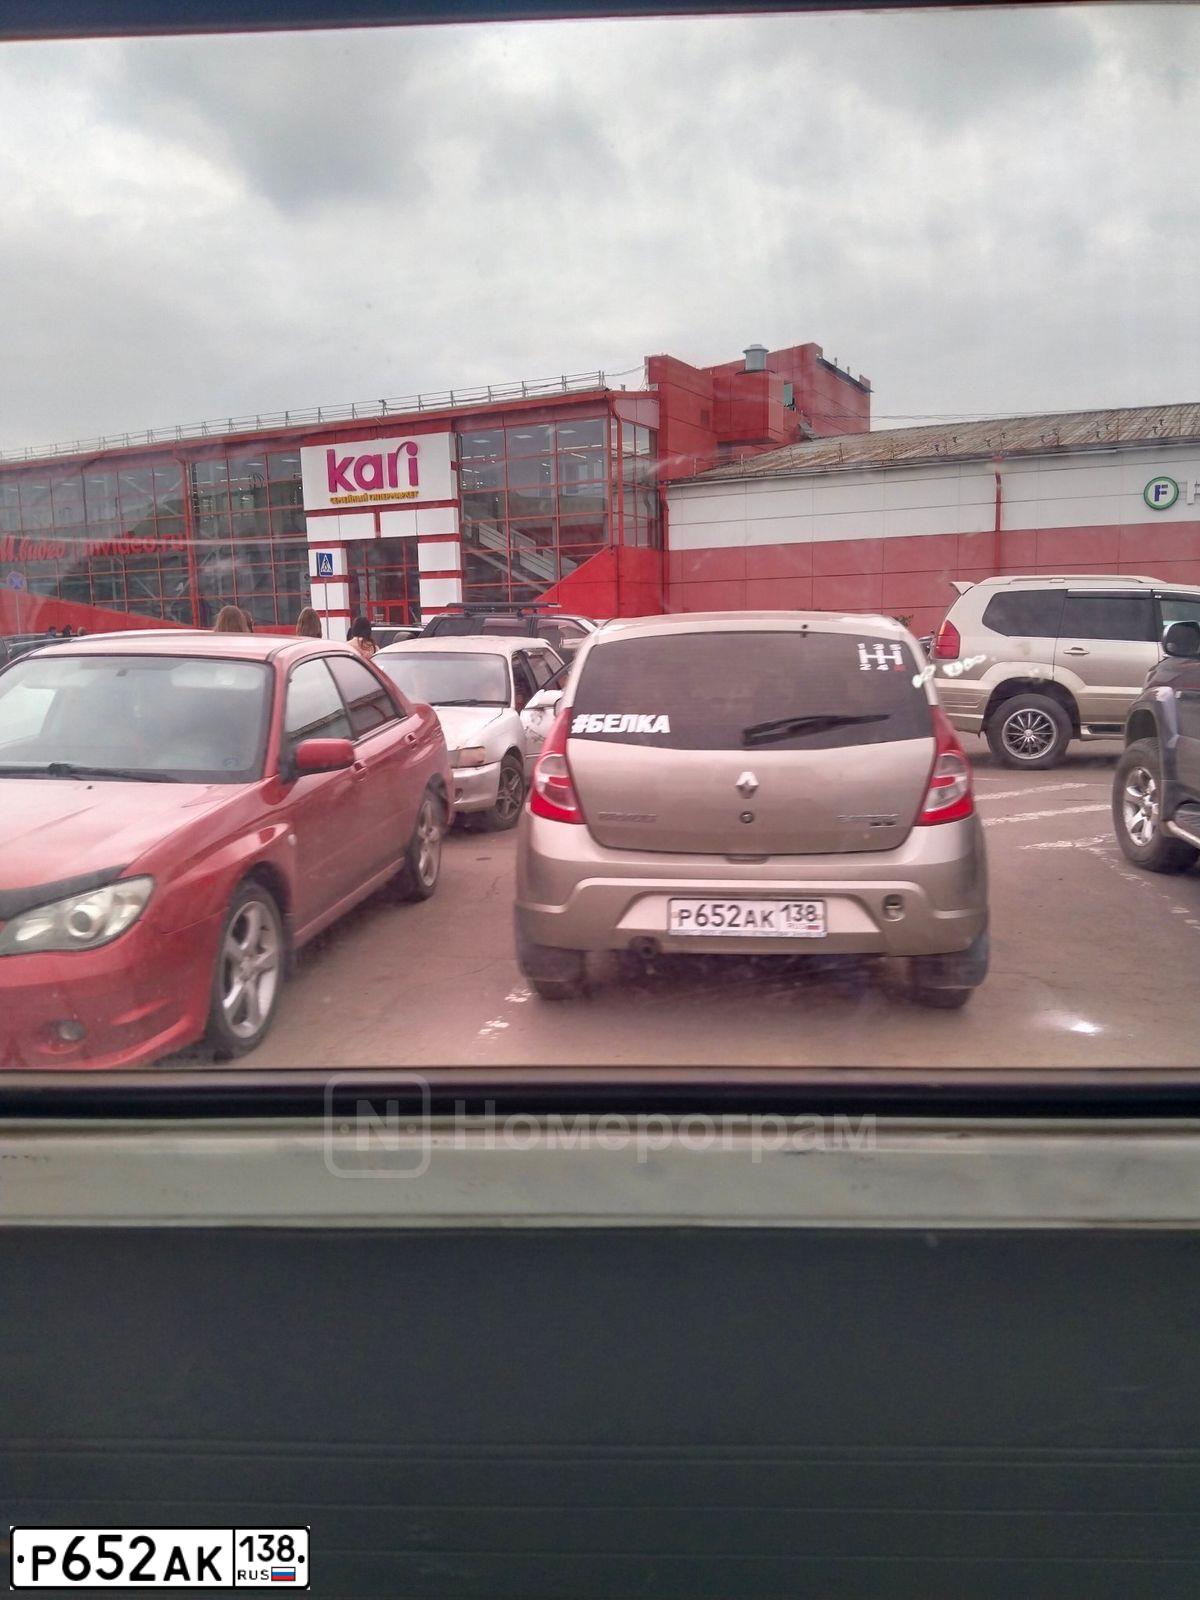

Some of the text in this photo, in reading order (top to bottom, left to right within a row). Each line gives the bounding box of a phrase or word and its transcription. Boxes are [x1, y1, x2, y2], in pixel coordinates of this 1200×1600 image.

[326, 441, 419, 493] kari
[1154, 484, 1168, 502] F
[571, 713, 671, 734] #БЕЛКА
[677, 904, 817, 928] Р652АК 138
